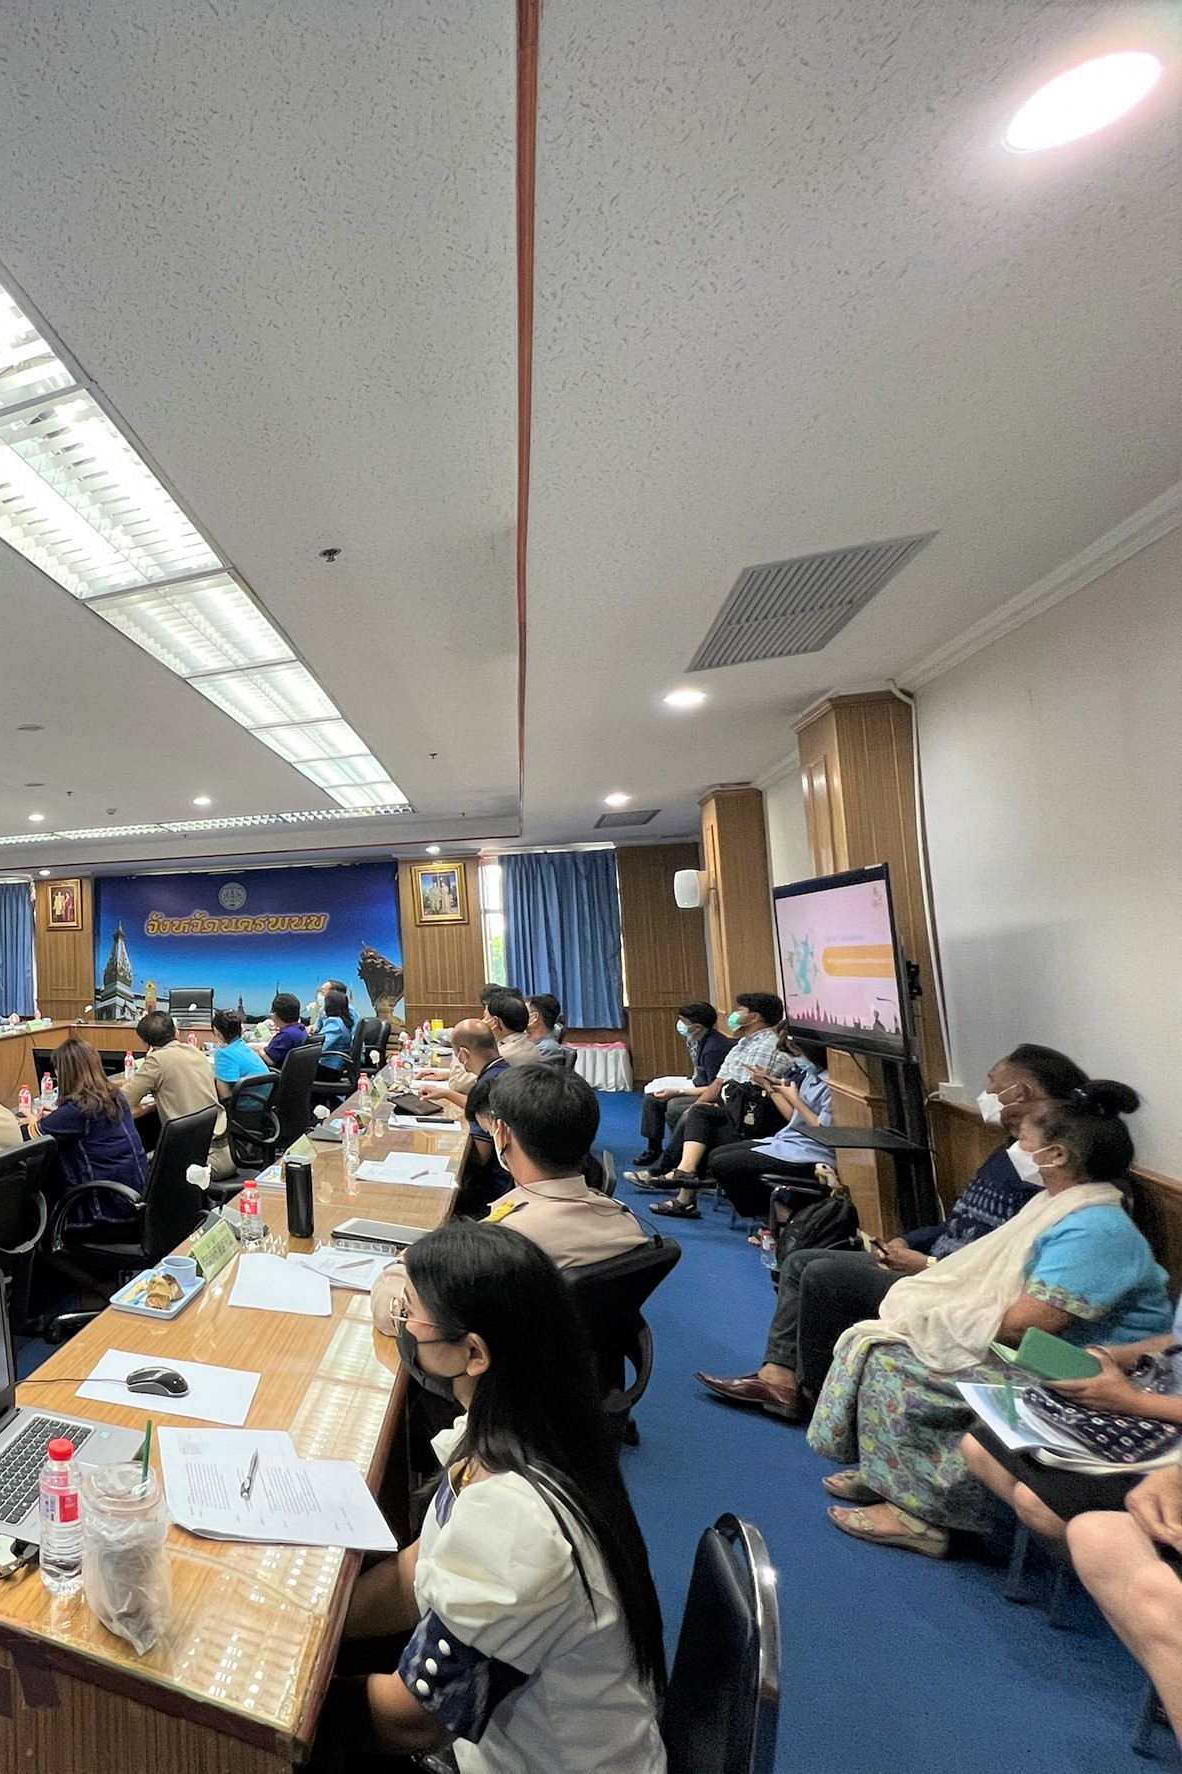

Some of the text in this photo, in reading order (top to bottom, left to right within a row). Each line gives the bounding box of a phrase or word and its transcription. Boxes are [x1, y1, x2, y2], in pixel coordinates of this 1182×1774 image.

[146, 911, 327, 934] จังหวัดนครพนม
